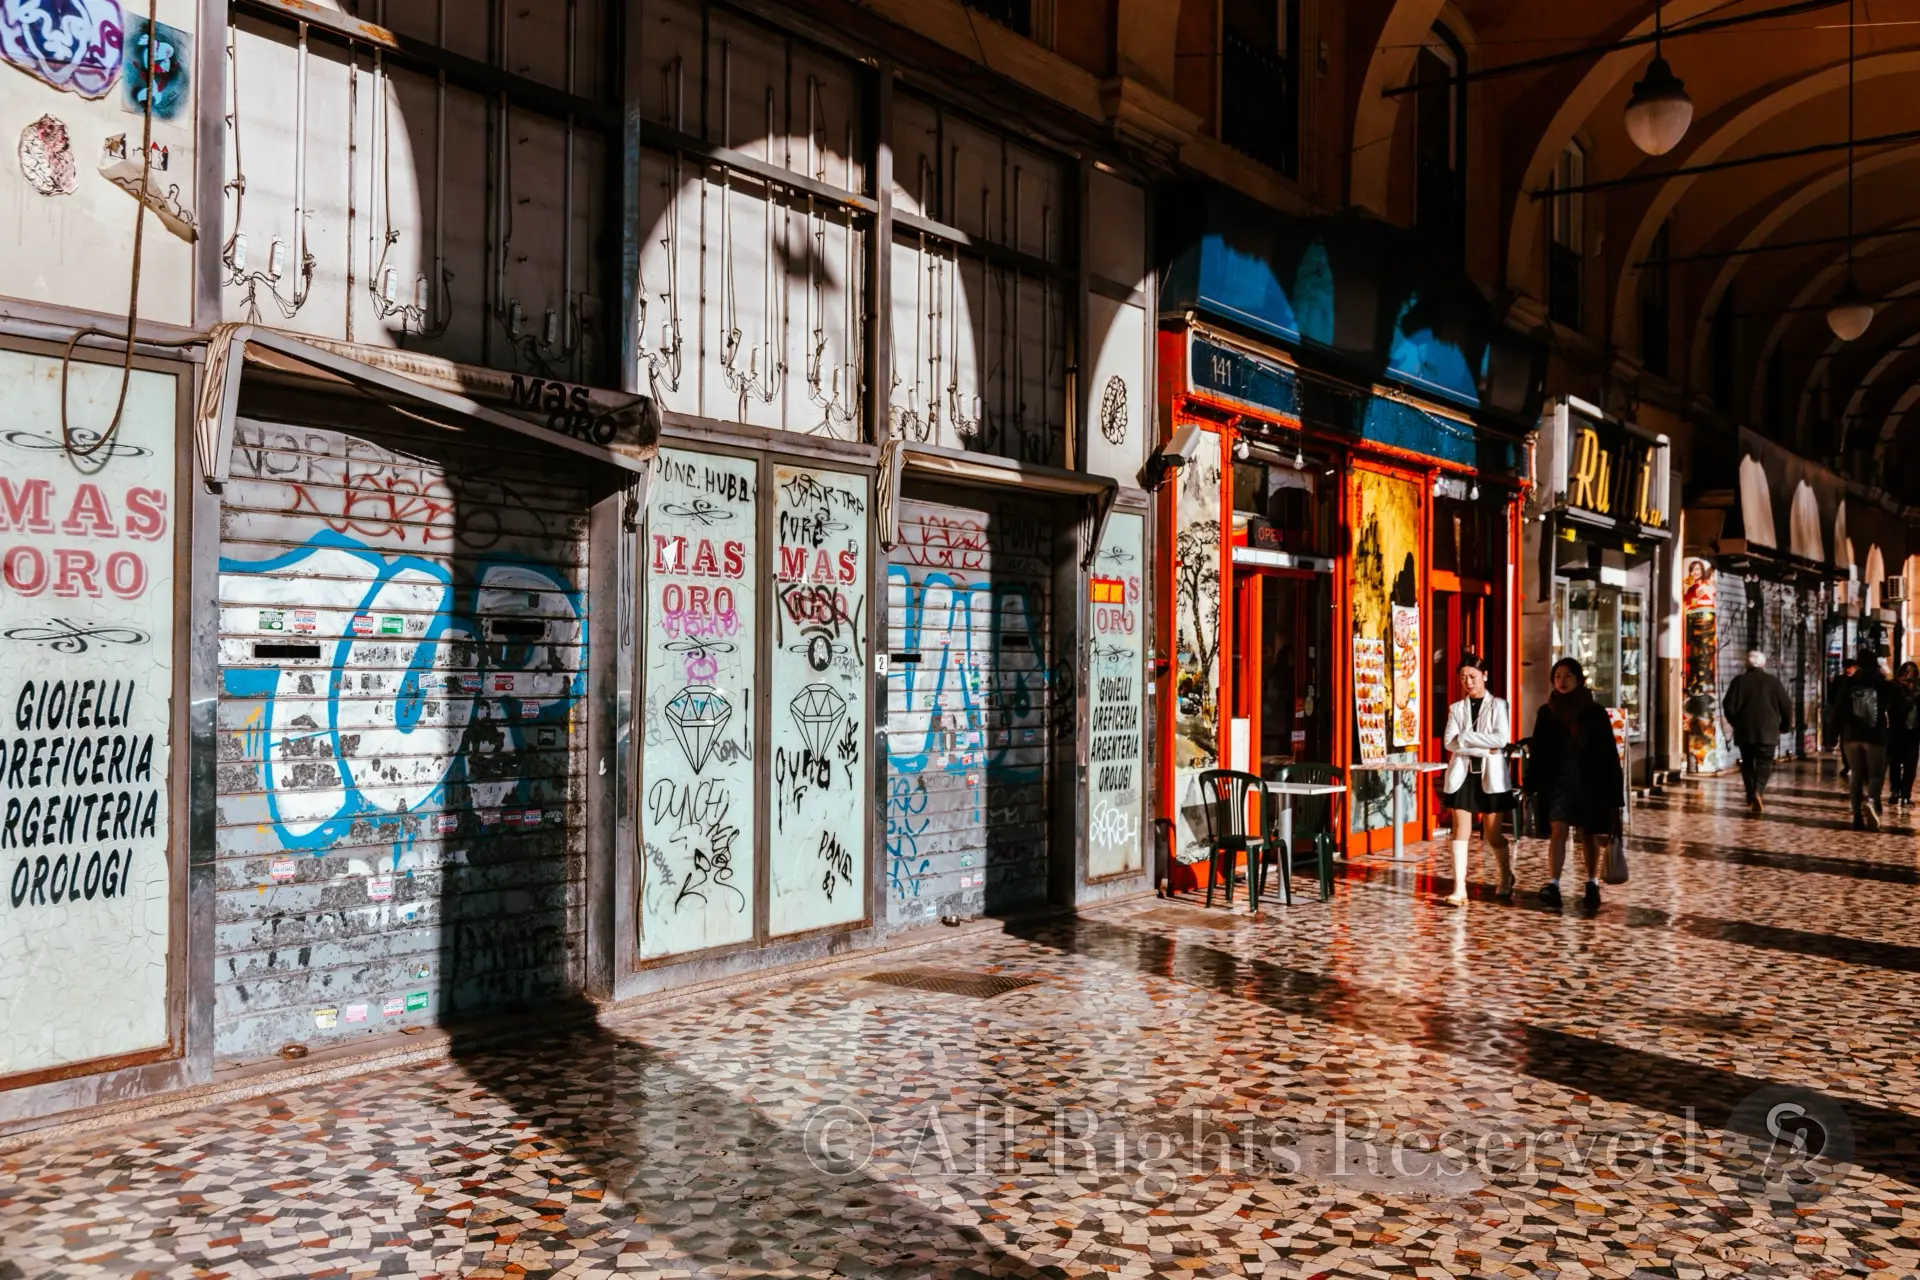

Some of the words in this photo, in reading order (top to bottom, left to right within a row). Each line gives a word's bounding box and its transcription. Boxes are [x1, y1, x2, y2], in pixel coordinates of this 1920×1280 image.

[1212, 355, 1232, 387] 141
[0, 476, 167, 541] MAS
[1258, 525, 1283, 542] OPEN
[3, 545, 149, 600] ORO
[653, 534, 746, 579] MAS
[778, 545, 857, 586] MAS
[662, 583, 736, 621] ORO
[1096, 608, 1135, 636] ORO
[878, 656, 885, 670] 2
[16, 679, 136, 731] GIOIELLI
[1099, 676, 1132, 702] GIOIELLI
[1092, 705, 1138, 732] OREFICERIA
[1091, 733, 1139, 762] ARGENTERIA
[1098, 765, 1132, 792] OROLOGI
[0, 788, 159, 849] RGENTERIA
[11, 848, 133, 908] OROLOGI
